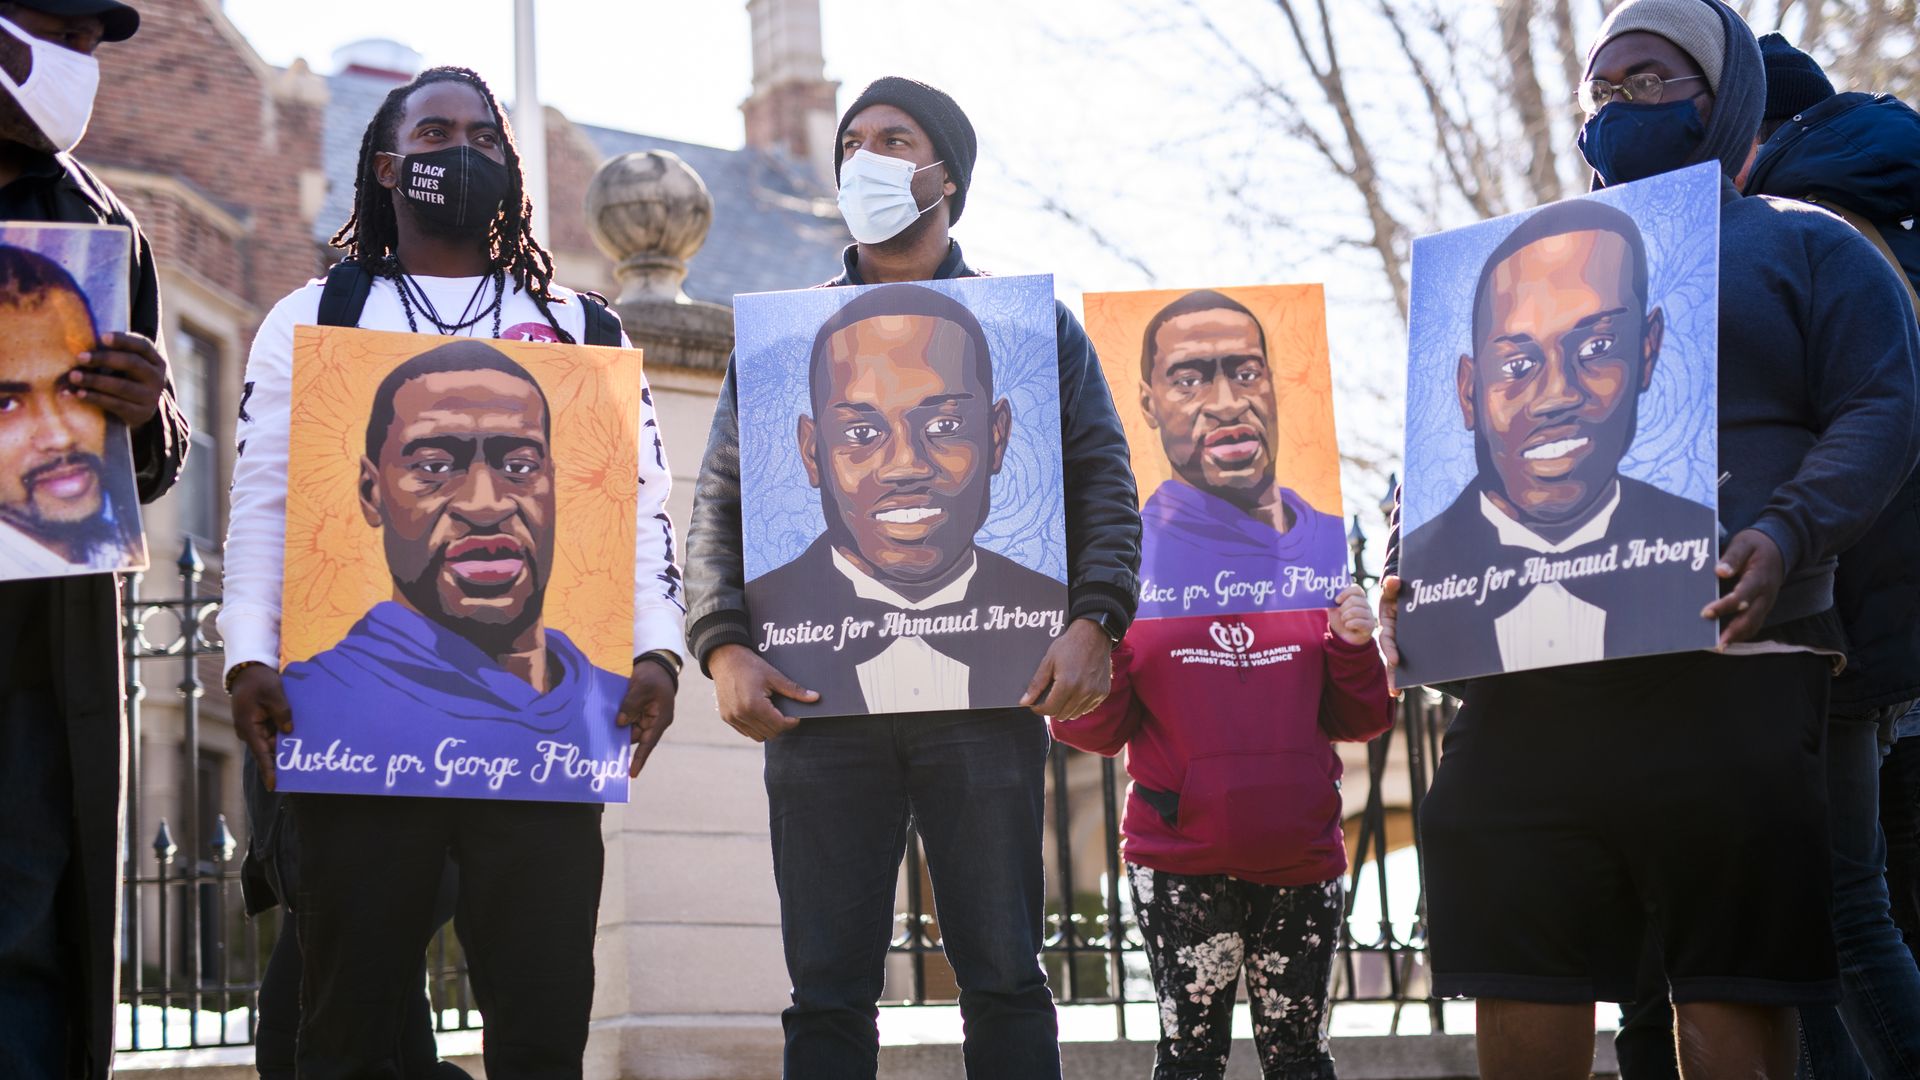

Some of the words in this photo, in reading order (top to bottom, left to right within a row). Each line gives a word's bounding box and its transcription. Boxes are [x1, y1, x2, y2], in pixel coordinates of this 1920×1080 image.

[412, 162, 446, 178] BLACK
[412, 176, 439, 190] LIVES
[408, 189, 445, 205] MATTER
[1405, 574, 1478, 613] Justice
[1475, 565, 1516, 606] for
[1518, 544, 1619, 587] Ahmaud
[1622, 537, 1710, 572] Arbery
[1138, 579, 1178, 603] tice
[1183, 583, 1210, 610] for
[1214, 570, 1276, 607] George
[1282, 564, 1350, 600] Floyd
[758, 620, 834, 652] Justice
[833, 616, 875, 651] for
[878, 608, 979, 638] Ahmaud
[983, 605, 1065, 638] Arbery
[1170, 647, 1209, 658] FAMILIES
[1210, 650, 1262, 660] SUPPOTNG
[1263, 644, 1301, 657] FAMILIES
[1182, 655, 1218, 665] AGAINST
[1251, 653, 1293, 667] VIOLENCE
[276, 738, 378, 773] Justice
[385, 753, 426, 788] for
[434, 737, 521, 790] George
[530, 740, 627, 792] Floyd
